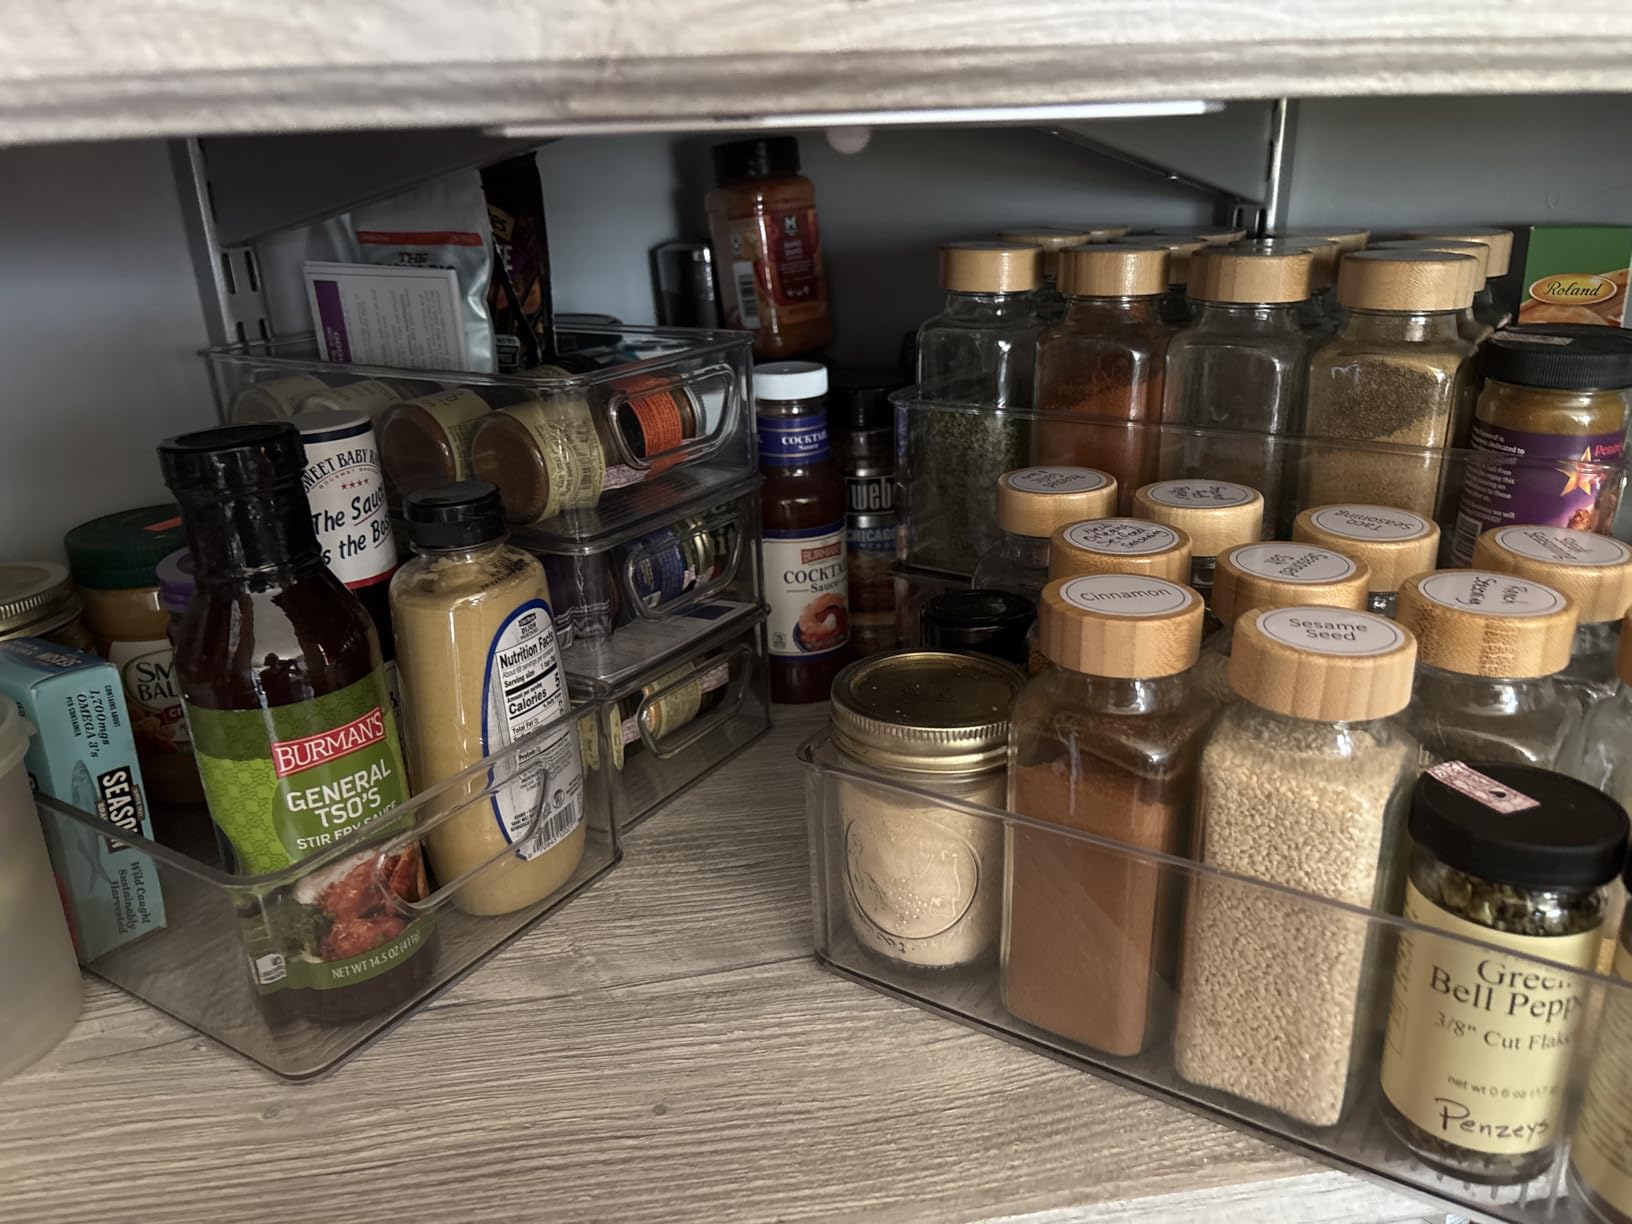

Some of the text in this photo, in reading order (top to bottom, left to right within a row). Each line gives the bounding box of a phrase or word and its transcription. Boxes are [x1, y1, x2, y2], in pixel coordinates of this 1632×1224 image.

[1543, 280, 1604, 297] Roland
[336, 448, 368, 468] BABY
[850, 477, 894, 511] web
[311, 509, 346, 536] The
[1333, 509, 1416, 530] Seasoning
[1346, 518, 1379, 532] Taco
[321, 548, 332, 566] s
[338, 533, 367, 560] the
[783, 560, 847, 585] COCKTA
[1080, 588, 1172, 602] Cinnamon
[1288, 617, 1369, 632] Sesame
[1305, 629, 1357, 641] Seed
[499, 642, 538, 670] Nutrition
[538, 630, 555, 651] Facts
[504, 674, 525, 688] Serving
[525, 669, 535, 678] size
[508, 671, 561, 716] Calories 5
[65, 696, 82, 738] PER CONTAINER
[89, 689, 110, 746] 1,700mgs
[104, 684, 121, 728] CONTAINS ABOUT
[76, 692, 101, 758] OMEGA 3's
[275, 710, 385, 772] BURMAN'S
[511, 721, 525, 735] Total
[286, 758, 392, 812] GENERAL
[314, 787, 381, 828] TSO'S
[296, 833, 332, 850] STIR
[110, 880, 129, 934] Harvested
[118, 868, 138, 931] Sustainably
[130, 860, 152, 924] Wild Caught
[331, 967, 350, 980] NET
[350, 960, 368, 975] WT
[369, 954, 388, 969] 14.5
[388, 948, 399, 962] OZ
[1430, 964, 1493, 1012] Bell
[1435, 1010, 1476, 1038] 3/8"
[1483, 1030, 1520, 1051] Cut
[1447, 1074, 1468, 1090] net
[1470, 1082, 1486, 1094] wt
[1434, 1097, 1550, 1142] Penzeys
